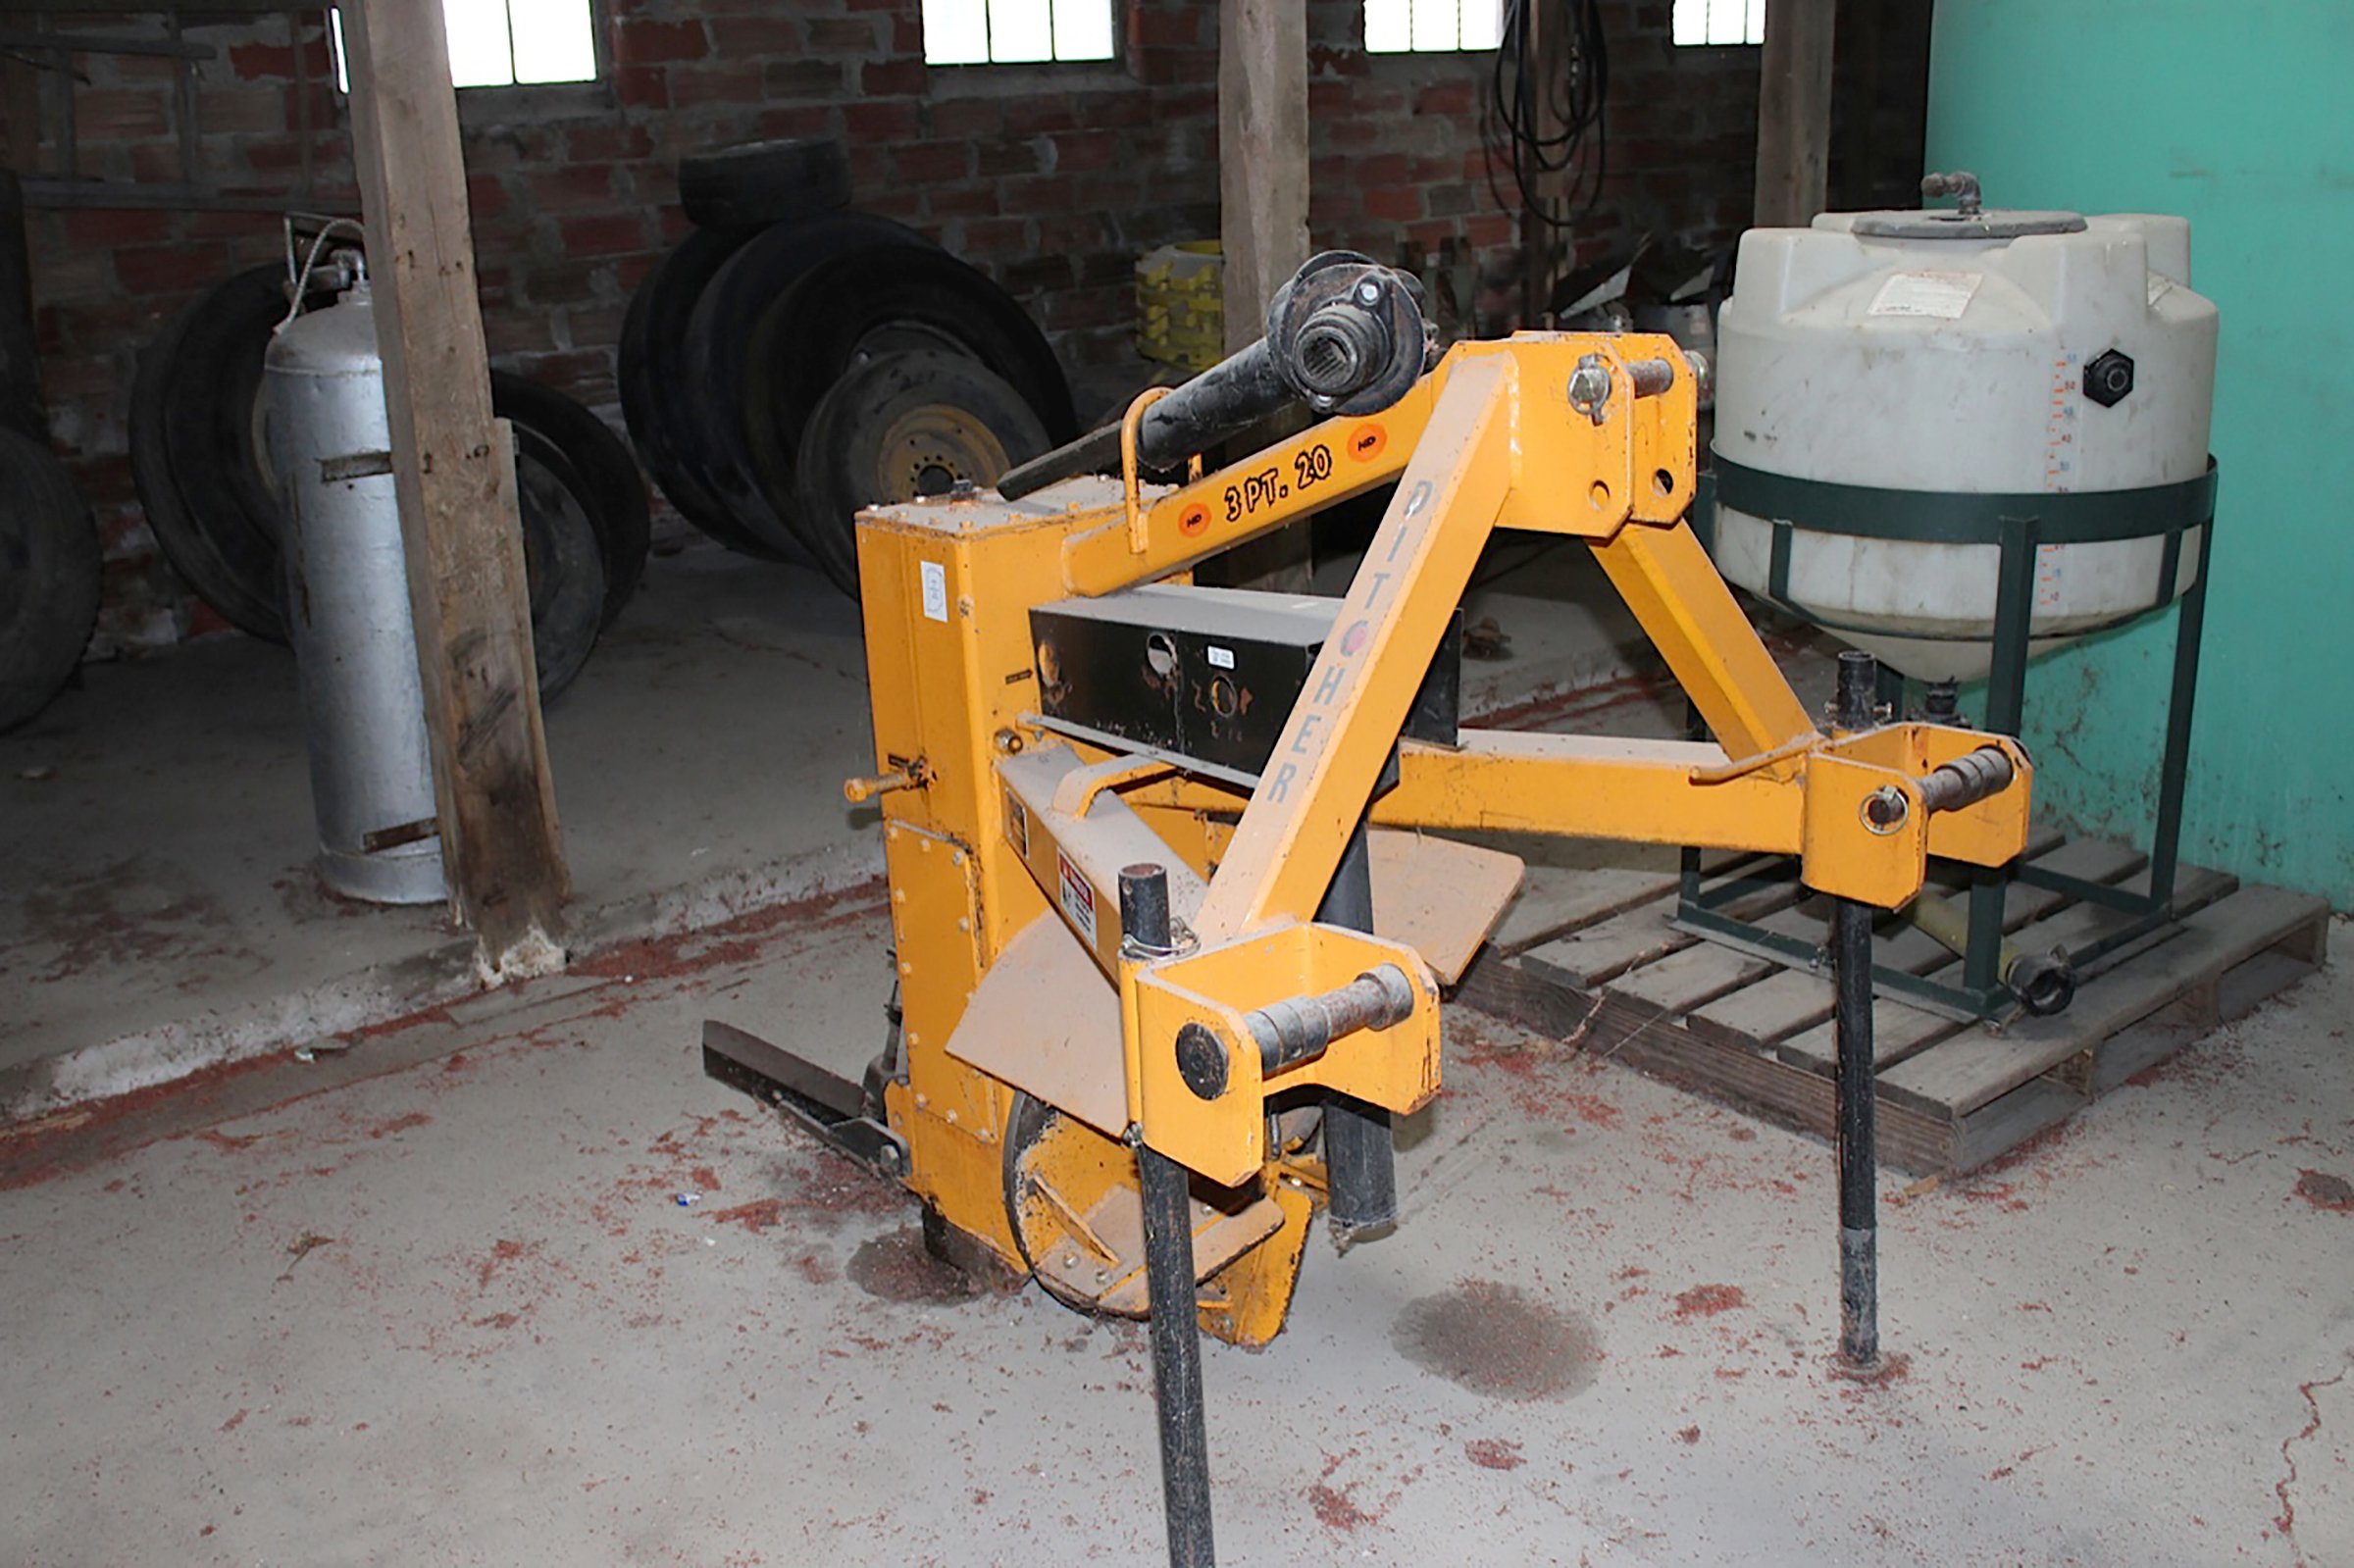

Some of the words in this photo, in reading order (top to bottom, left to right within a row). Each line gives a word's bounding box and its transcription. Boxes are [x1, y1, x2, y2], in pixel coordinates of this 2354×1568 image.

[1294, 443, 1333, 490] 20
[1186, 513, 1203, 529] HD
[1266, 480, 1434, 804] DITCHER
